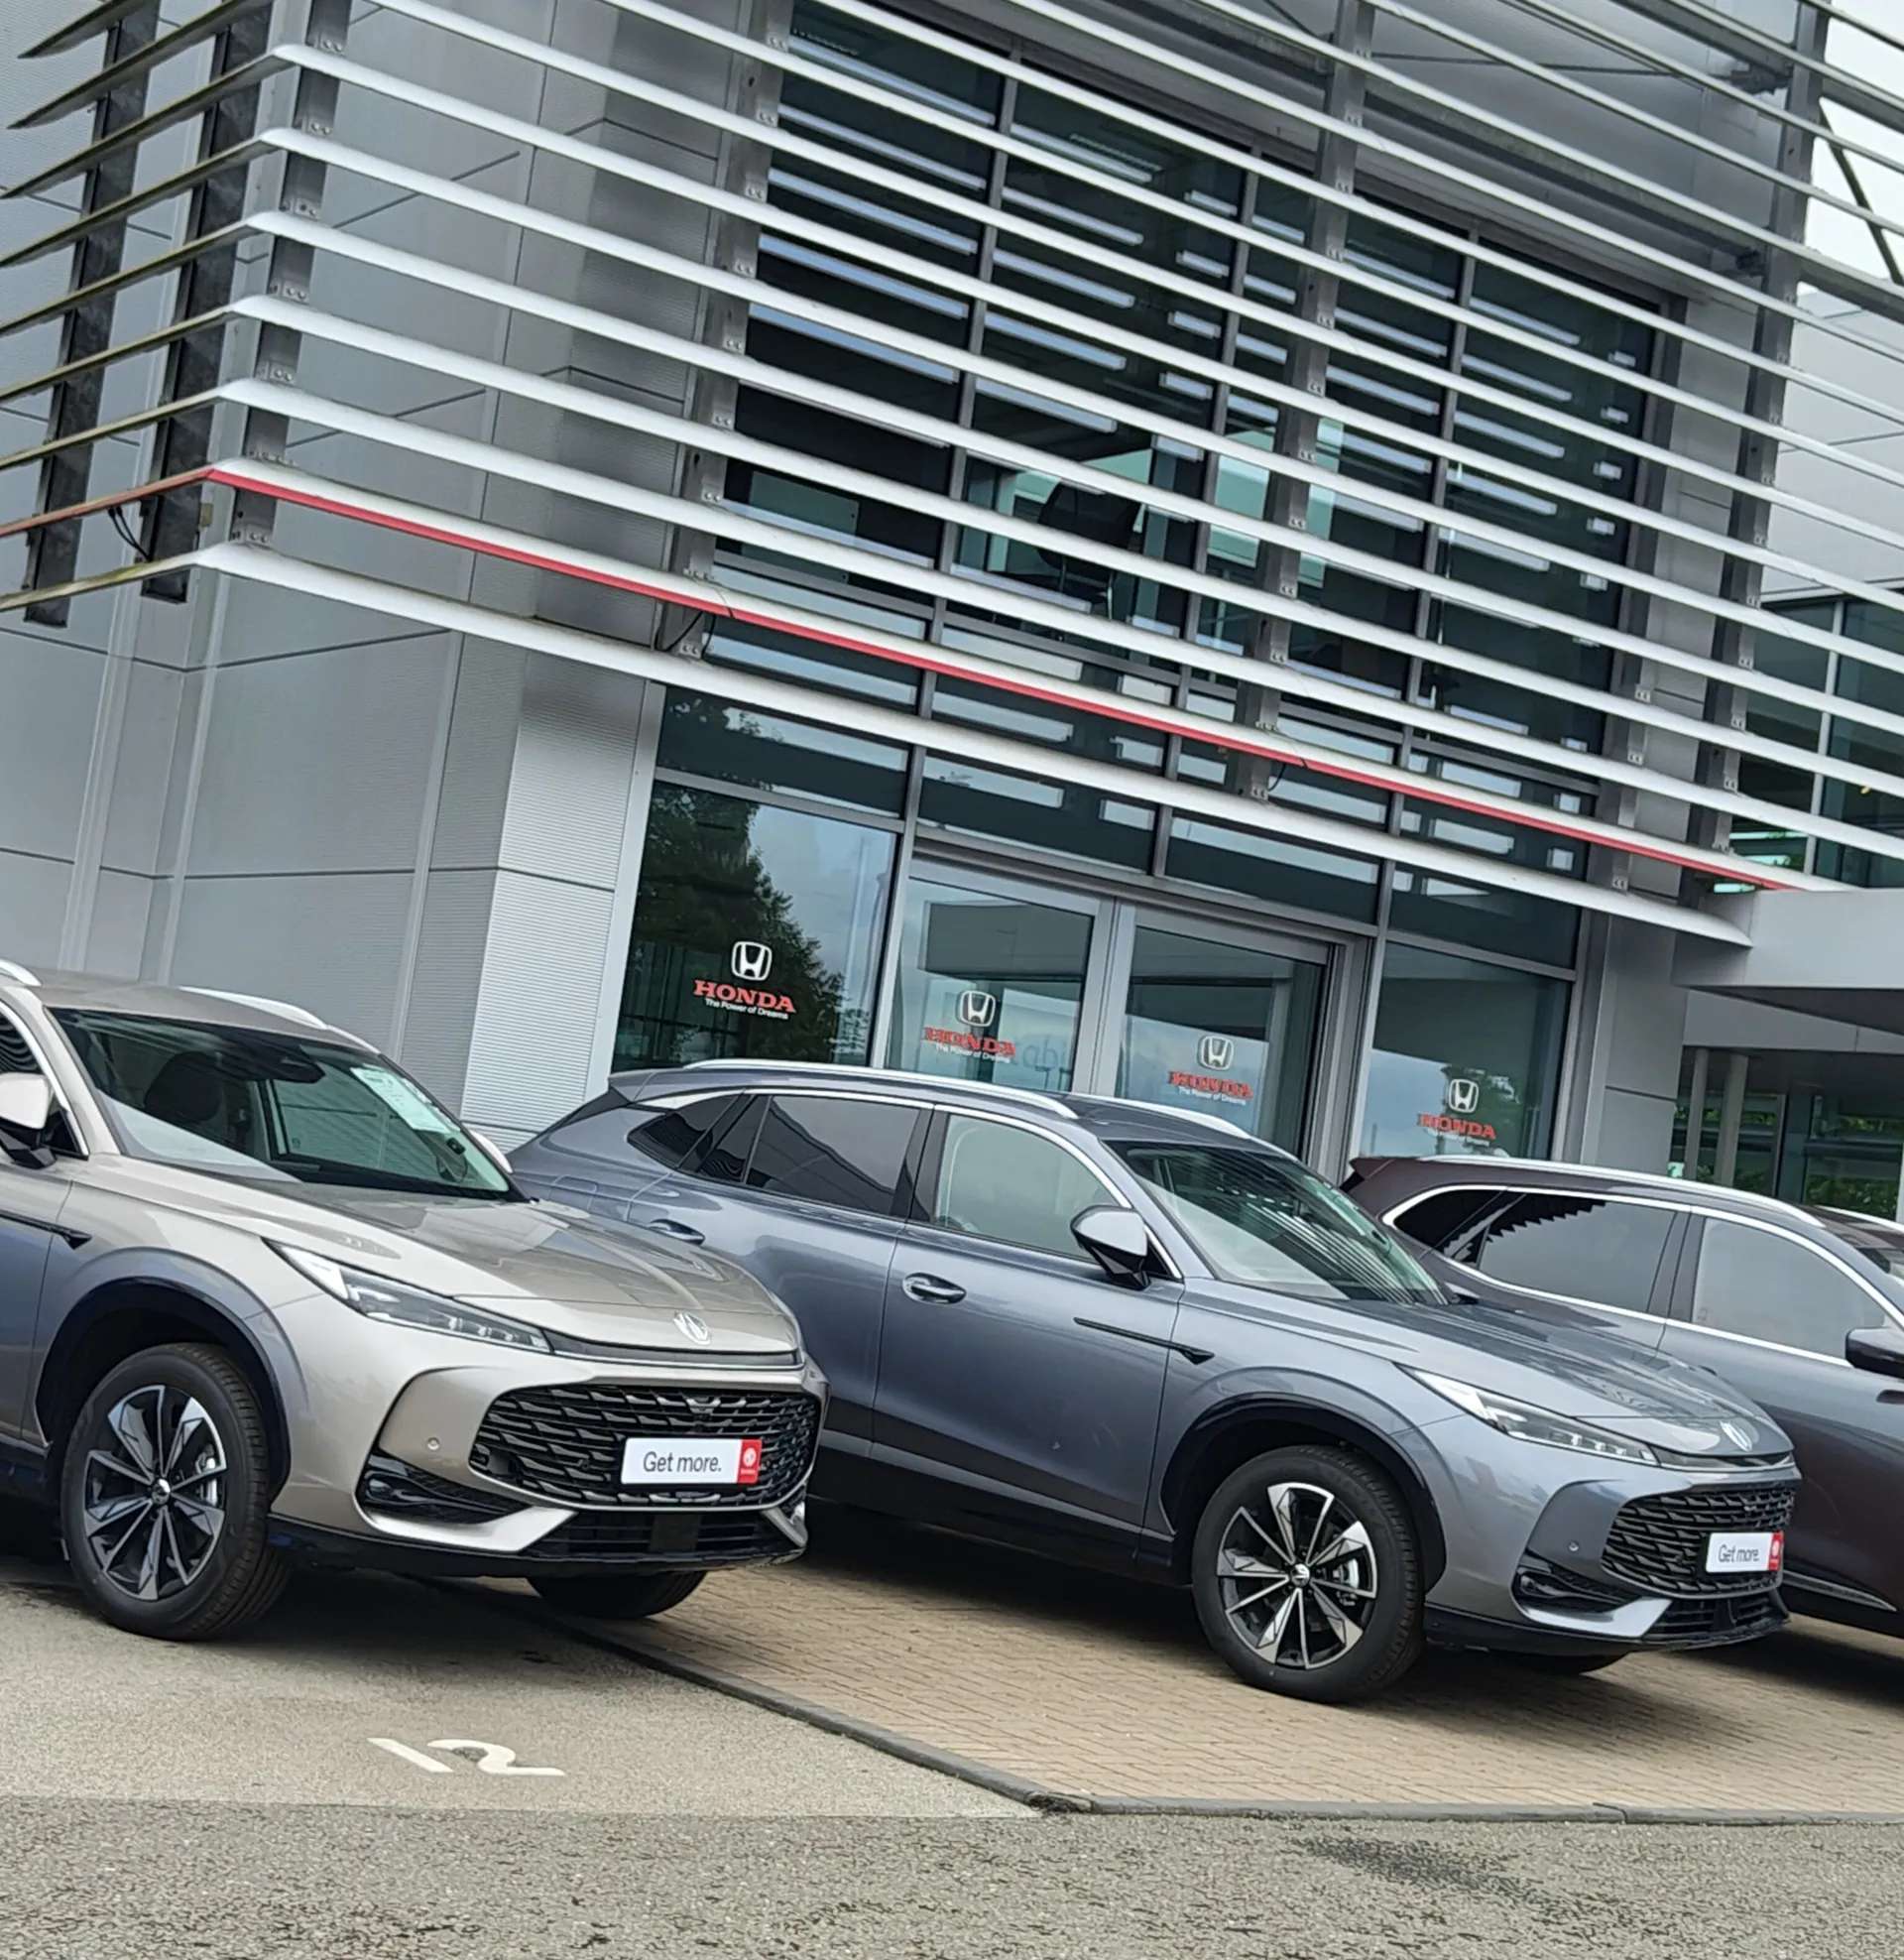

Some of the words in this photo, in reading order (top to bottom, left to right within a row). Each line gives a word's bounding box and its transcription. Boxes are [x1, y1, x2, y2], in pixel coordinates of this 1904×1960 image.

[693, 979, 796, 1013] HONDA
[705, 998, 720, 1008] The
[721, 1001, 747, 1013] Power
[747, 1006, 758, 1015] of
[758, 1007, 789, 1021] Dreams
[923, 1027, 1016, 1057] HONDA
[1417, 1113, 1496, 1140] HONDA
[643, 1451, 673, 1473] Get
[676, 1455, 722, 1473] more.
[1718, 1544, 1736, 1563] Get
[366, 1737, 566, 1776] 12
